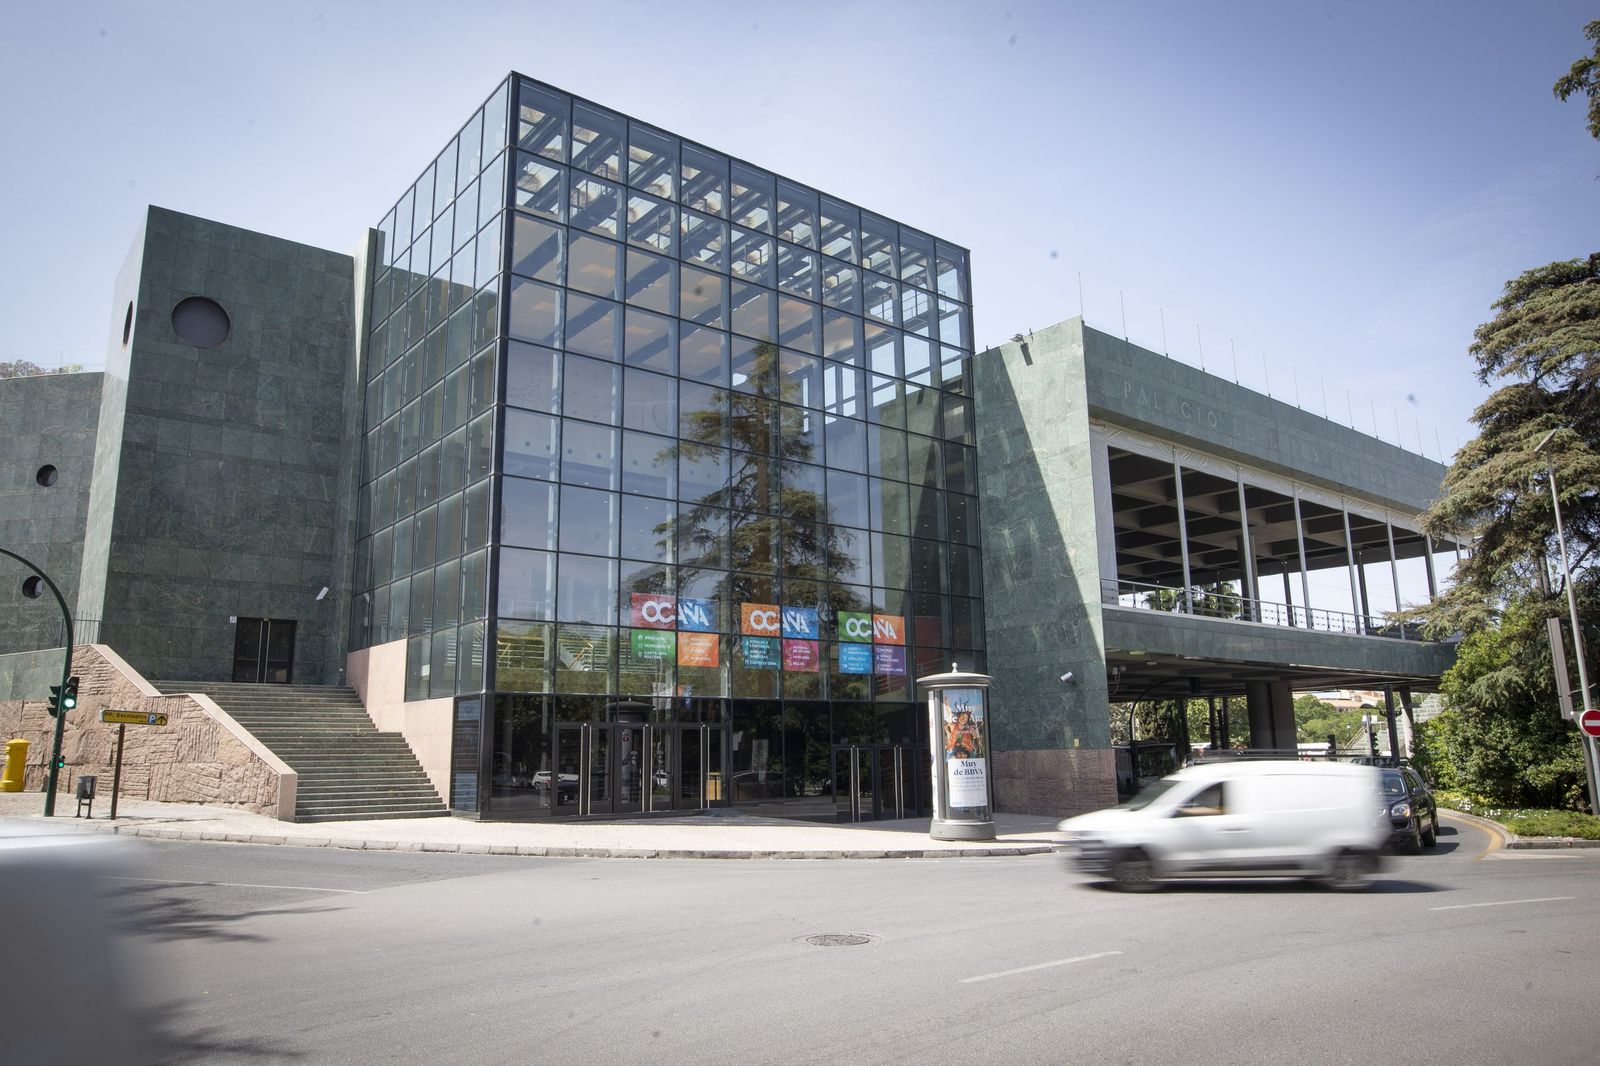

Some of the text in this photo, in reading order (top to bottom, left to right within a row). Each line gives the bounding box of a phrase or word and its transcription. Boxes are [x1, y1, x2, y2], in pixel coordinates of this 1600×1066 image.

[642, 600, 710, 627] OCAÑA
[750, 609, 810, 634] OCAÑA
[845, 617, 897, 640] OCAÑA
[953, 768, 983, 776] de BBVA
[960, 760, 977, 769] Muy
